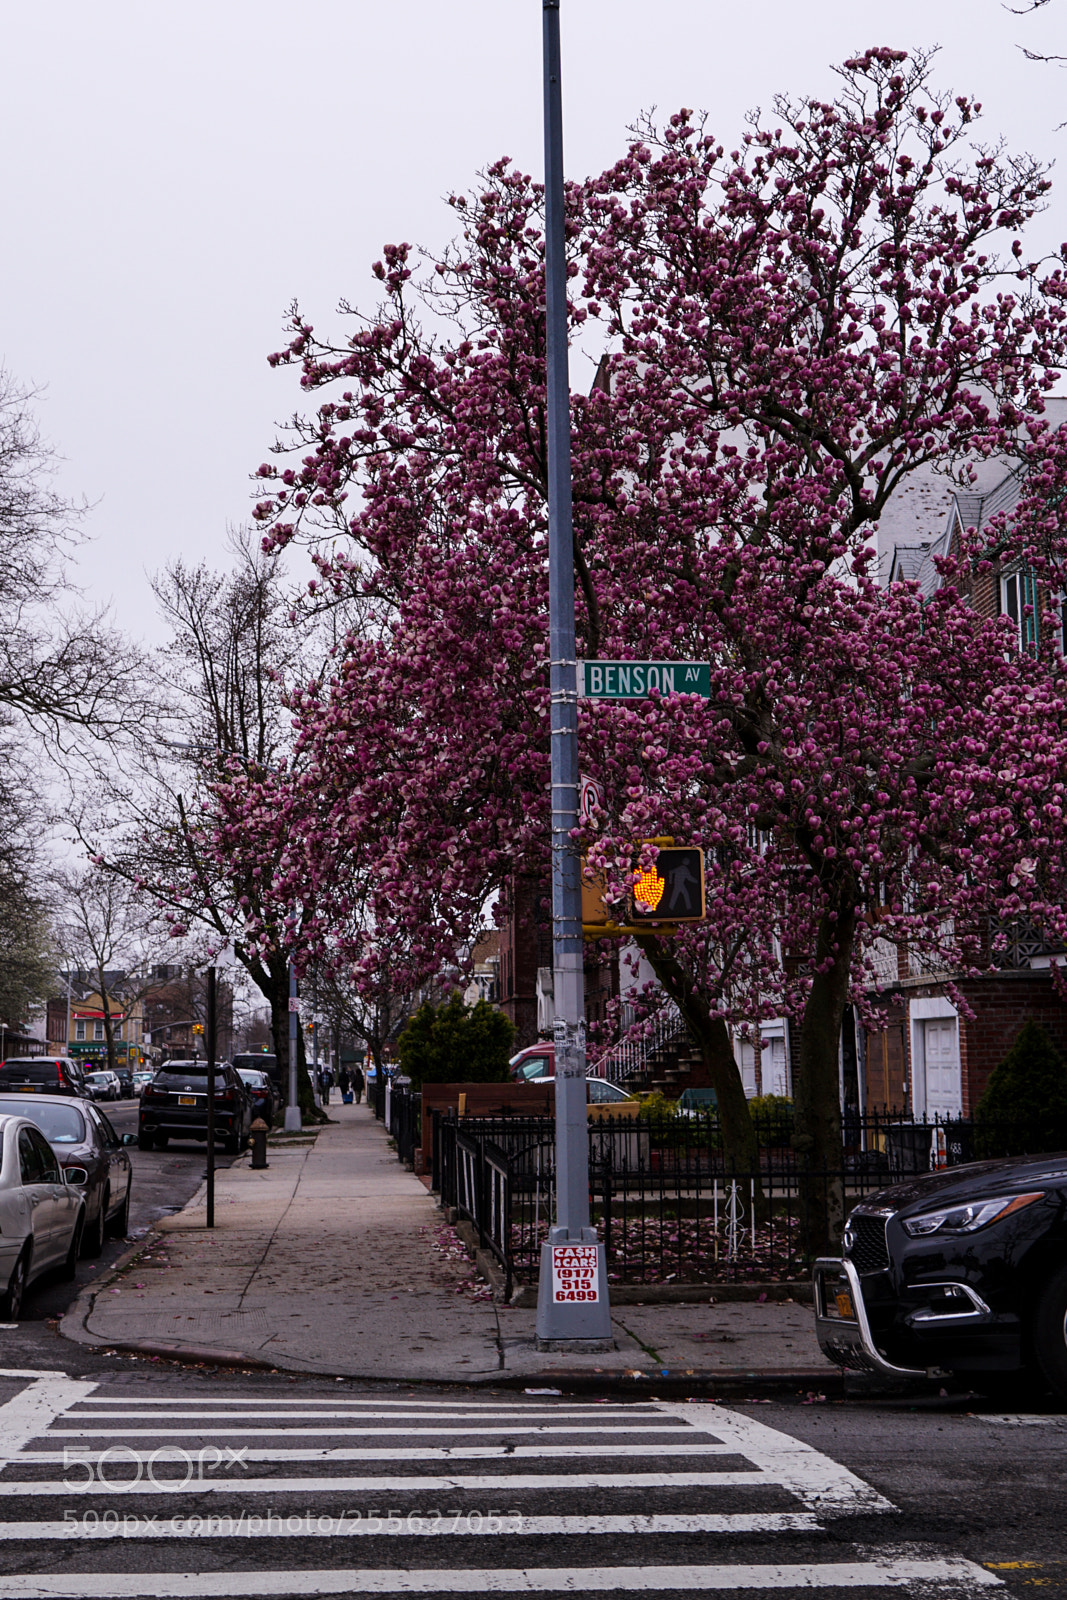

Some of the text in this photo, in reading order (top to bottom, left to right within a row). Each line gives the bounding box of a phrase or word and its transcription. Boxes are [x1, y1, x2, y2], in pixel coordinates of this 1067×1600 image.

[590, 666, 700, 694] BENSON AV
[557, 1268, 594, 1279] (917)
[562, 1279, 591, 1290] 515
[555, 1290, 597, 1302] 6499
